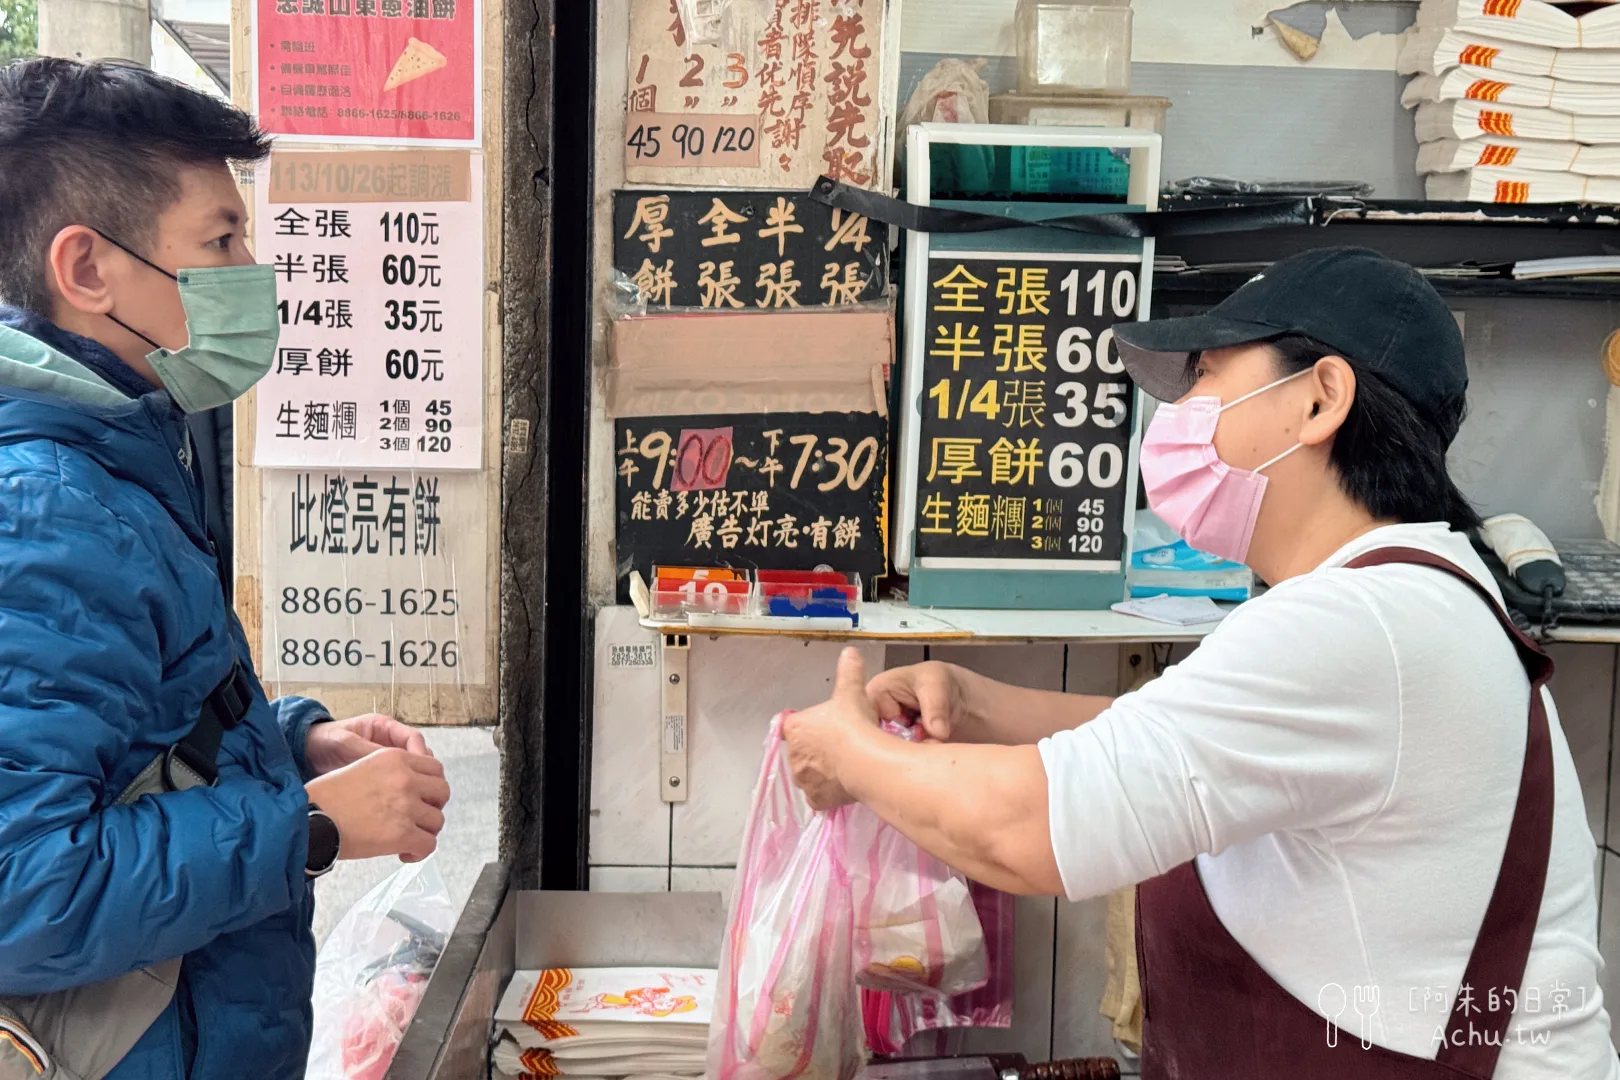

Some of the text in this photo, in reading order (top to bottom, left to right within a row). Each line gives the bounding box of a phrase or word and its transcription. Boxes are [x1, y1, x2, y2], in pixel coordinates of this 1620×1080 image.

[822, 0, 871, 185] 先說先取
[627, 124, 661, 158] 45
[672, 124, 704, 158] 90
[274, 207, 439, 245] 全張 110元
[274, 252, 441, 288] 半張 60元
[933, 264, 1136, 317] 全張 110
[277, 299, 443, 333] 1/4張 35元
[276, 347, 444, 382] 厚餅 60元
[930, 322, 1048, 373] 半張
[379, 400, 411, 414] 1個
[425, 400, 452, 416] 45
[929, 378, 1127, 428] 1/4張 35
[379, 417, 452, 433] 2個 90
[379, 436, 451, 452] 3個 120
[926, 437, 1123, 488] 厚餅 60
[290, 473, 441, 556] 此燈亮有餅
[1032, 498, 1063, 514] 1個
[1077, 499, 1105, 515] 45
[1031, 515, 1104, 533] 2個 90
[1031, 535, 1102, 553] 3個 120
[281, 586, 459, 616] 8866-1625
[281, 638, 458, 668] 8866-1626
